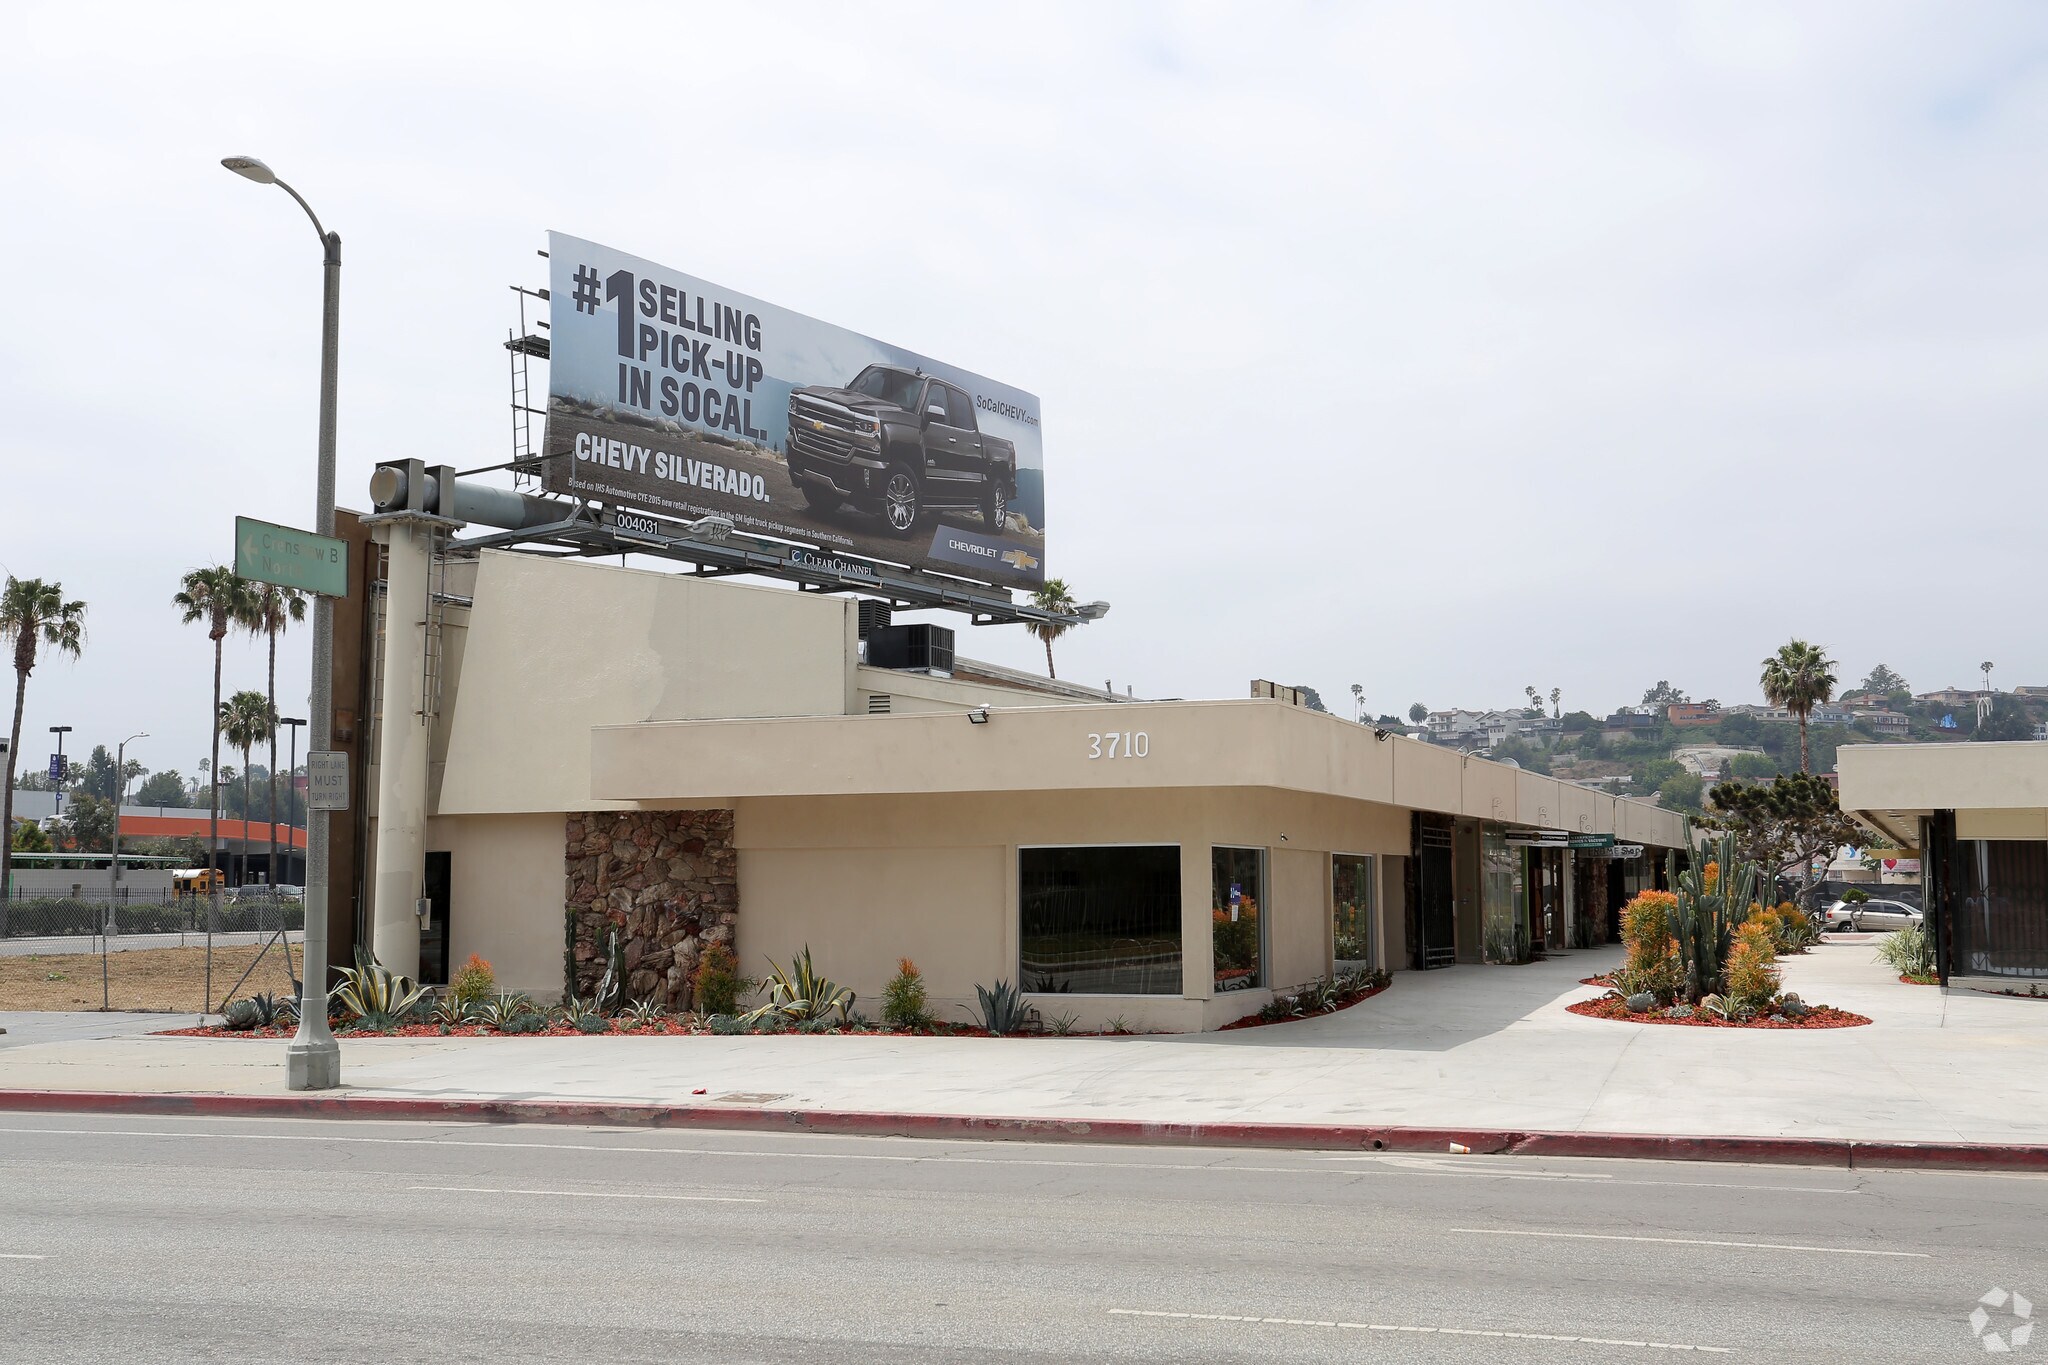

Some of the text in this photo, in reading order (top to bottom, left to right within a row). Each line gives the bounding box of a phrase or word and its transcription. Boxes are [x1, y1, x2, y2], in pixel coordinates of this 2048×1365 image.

[639, 279, 761, 352] SELLING
[639, 322, 763, 393] PICK-UP
[619, 363, 767, 441] IN SOCAL.
[976, 395, 1039, 427] SoCalCHEVY.com
[575, 432, 770, 502] CHEVY SILVERADO.
[587, 482, 594, 491] on
[595, 483, 605, 493] IHS
[605, 485, 637, 500] Automotive
[649, 494, 661, 505] 2015
[661, 500, 672, 508] new
[672, 501, 687, 511] retail
[726, 511, 735, 521] the
[744, 516, 755, 526] light
[755, 518, 768, 527] truck
[768, 521, 784, 533] pickup
[784, 525, 806, 537] segments
[806, 529, 812, 537] in
[812, 529, 832, 541] Southern
[617, 513, 658, 535] 004031
[263, 534, 325, 560] Crensw
[949, 539, 997, 558] CHEVROLET
[1088, 731, 1149, 759] 3710
[311, 760, 345, 770] RIGHT LANE
[314, 775, 343, 786] MUST
[311, 792, 346, 801] TURN RIGHT
